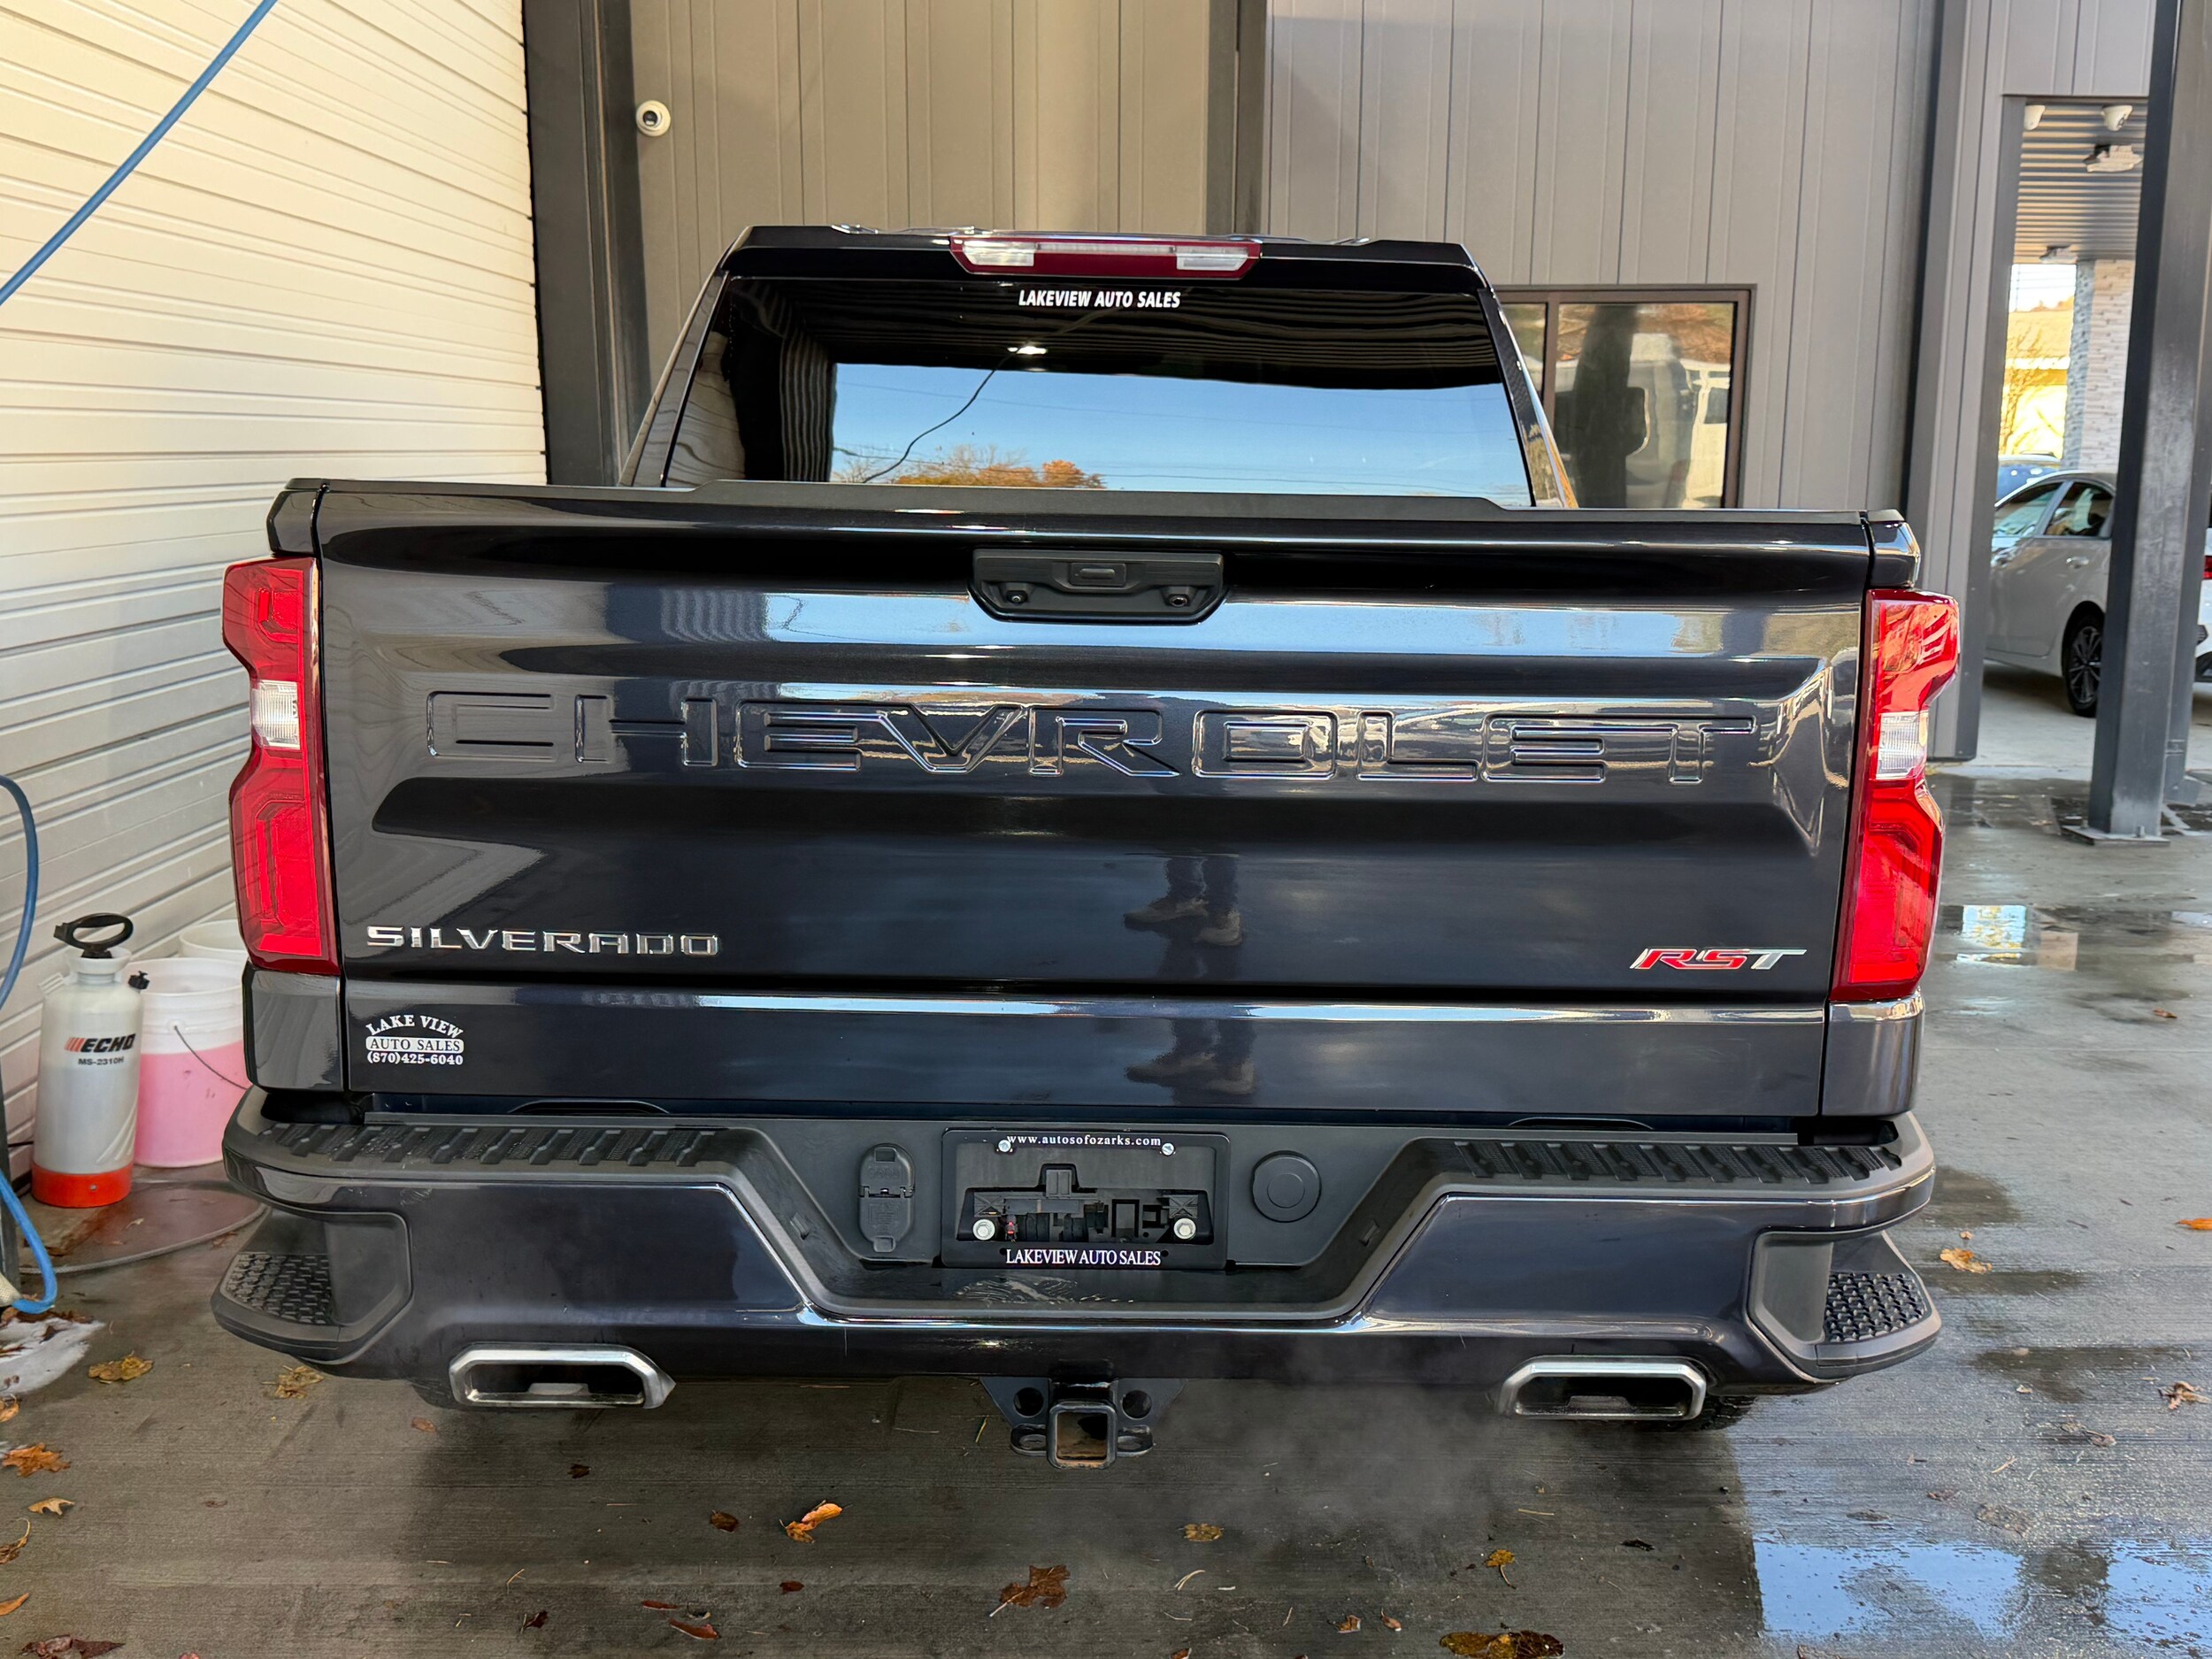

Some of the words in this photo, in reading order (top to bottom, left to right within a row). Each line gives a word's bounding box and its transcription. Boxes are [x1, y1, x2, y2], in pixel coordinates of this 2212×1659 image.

[1018, 289, 1092, 307] LAKEVIEW
[1094, 291, 1133, 308] AUTO
[1137, 291, 1181, 308] SALES
[426, 688, 1759, 786] CHEVROLET
[366, 926, 720, 956] SILVERADO
[1629, 948, 1808, 970] RST
[365, 1014, 415, 1035] LAKE
[420, 1015, 464, 1039] VIEW
[80, 1033, 136, 1053] ECHO
[370, 1039, 411, 1050] AUTO
[417, 1040, 460, 1052] SALES
[366, 1051, 464, 1065] (870)425-6040
[1006, 1134, 1162, 1147] www.autosofozarks.com
[1006, 1248, 1079, 1264] LAKEVIEW
[1079, 1249, 1118, 1265] AUTO
[1119, 1250, 1162, 1265] SALES
